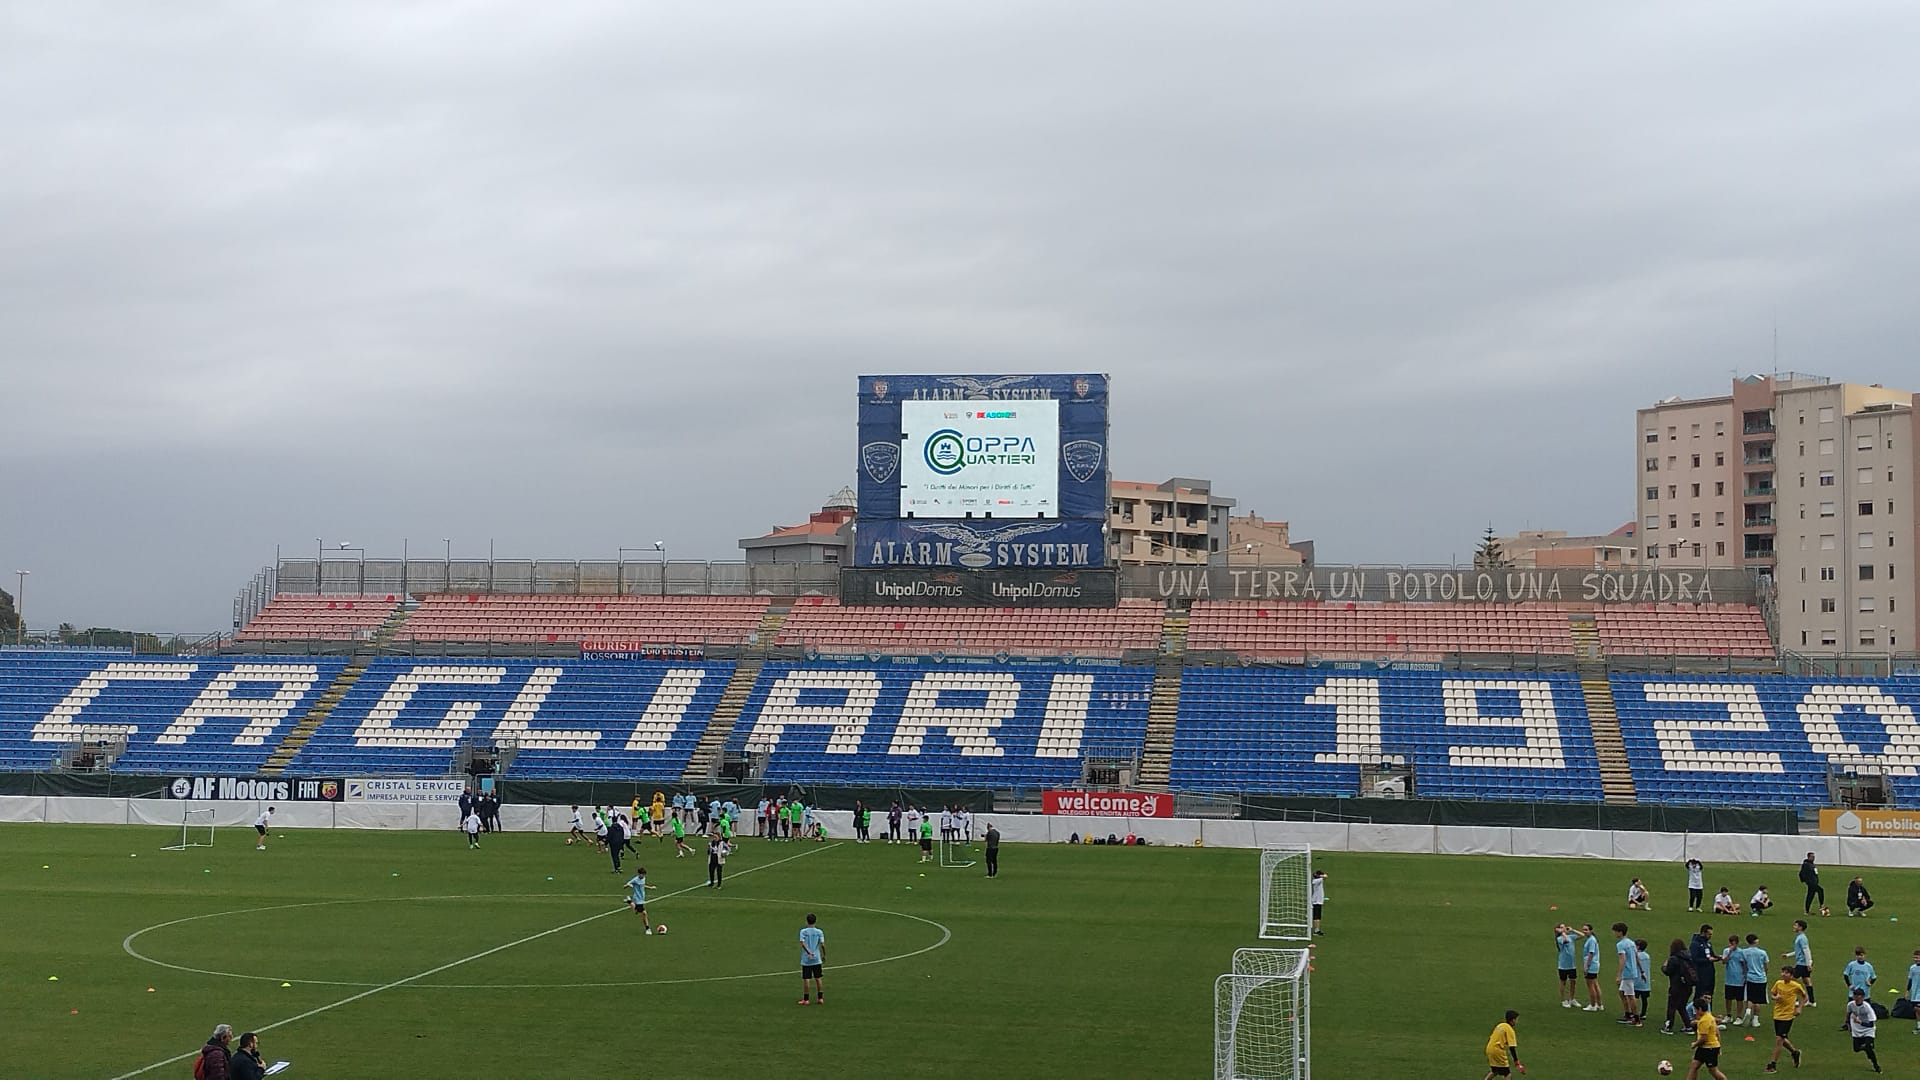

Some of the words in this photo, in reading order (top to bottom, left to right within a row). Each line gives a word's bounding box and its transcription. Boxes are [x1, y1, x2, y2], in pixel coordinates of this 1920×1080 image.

[912, 388, 964, 400] ALARM
[991, 388, 1051, 400] SYSTEM
[871, 541, 953, 567] ALARM
[997, 543, 1090, 567] SYSTEM
[875, 581, 963, 600] UnipolDomus
[992, 582, 1081, 601] UnipolDomus
[1158, 570, 1210, 598] UNA
[1228, 570, 1321, 599] TERRA,
[1328, 571, 1366, 598] UN
[1386, 572, 1497, 603] POPOLO,
[1506, 572, 1562, 601] UNA
[1581, 573, 1714, 602] SQUADRA
[583, 641, 639, 651] GIURISTI
[583, 652, 639, 661] ROSSOBLU
[892, 657, 919, 665] ORISTANO
[31, 662, 1095, 759] CAGLIARI
[192, 778, 215, 800] AF
[218, 778, 289, 801] Motors
[298, 779, 320, 799] FIAT
[366, 780, 413, 791] CRISTAL
[415, 781, 463, 791] SERVICE
[367, 793, 398, 801] IMPRESA
[1057, 793, 1140, 811] welcome
